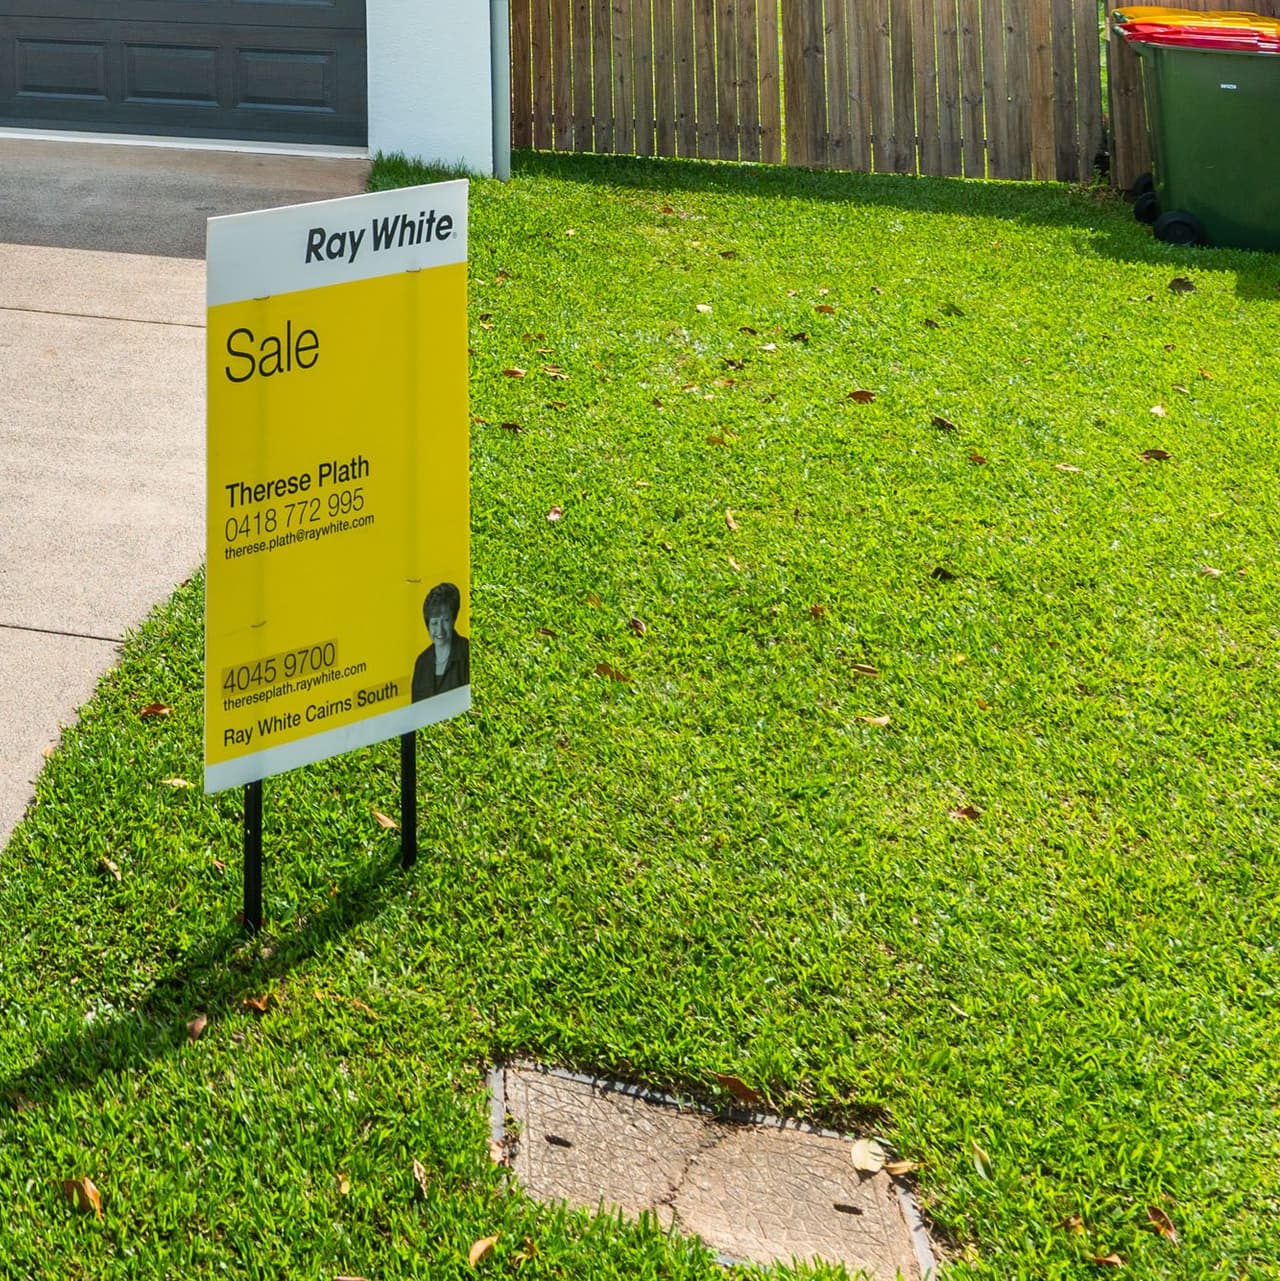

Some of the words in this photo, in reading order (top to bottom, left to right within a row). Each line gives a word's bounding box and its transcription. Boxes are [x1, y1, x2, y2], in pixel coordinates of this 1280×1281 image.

[305, 227, 366, 263] Ray
[372, 210, 453, 251] White
[225, 319, 319, 383] Sale
[225, 472, 311, 508] Therese
[319, 455, 369, 487] Plath
[225, 508, 277, 542] 0418
[284, 498, 321, 528] 772
[328, 487, 364, 516] 995
[225, 513, 374, 560] therese.plath@raywhite.com
[223, 659, 276, 693] 4045
[284, 642, 335, 678] 9700
[223, 661, 367, 711] thereseplath.raywhite.com
[224, 727, 253, 746] Ray
[258, 713, 301, 737] White
[306, 697, 352, 722] Cairns
[357, 682, 398, 708] South
